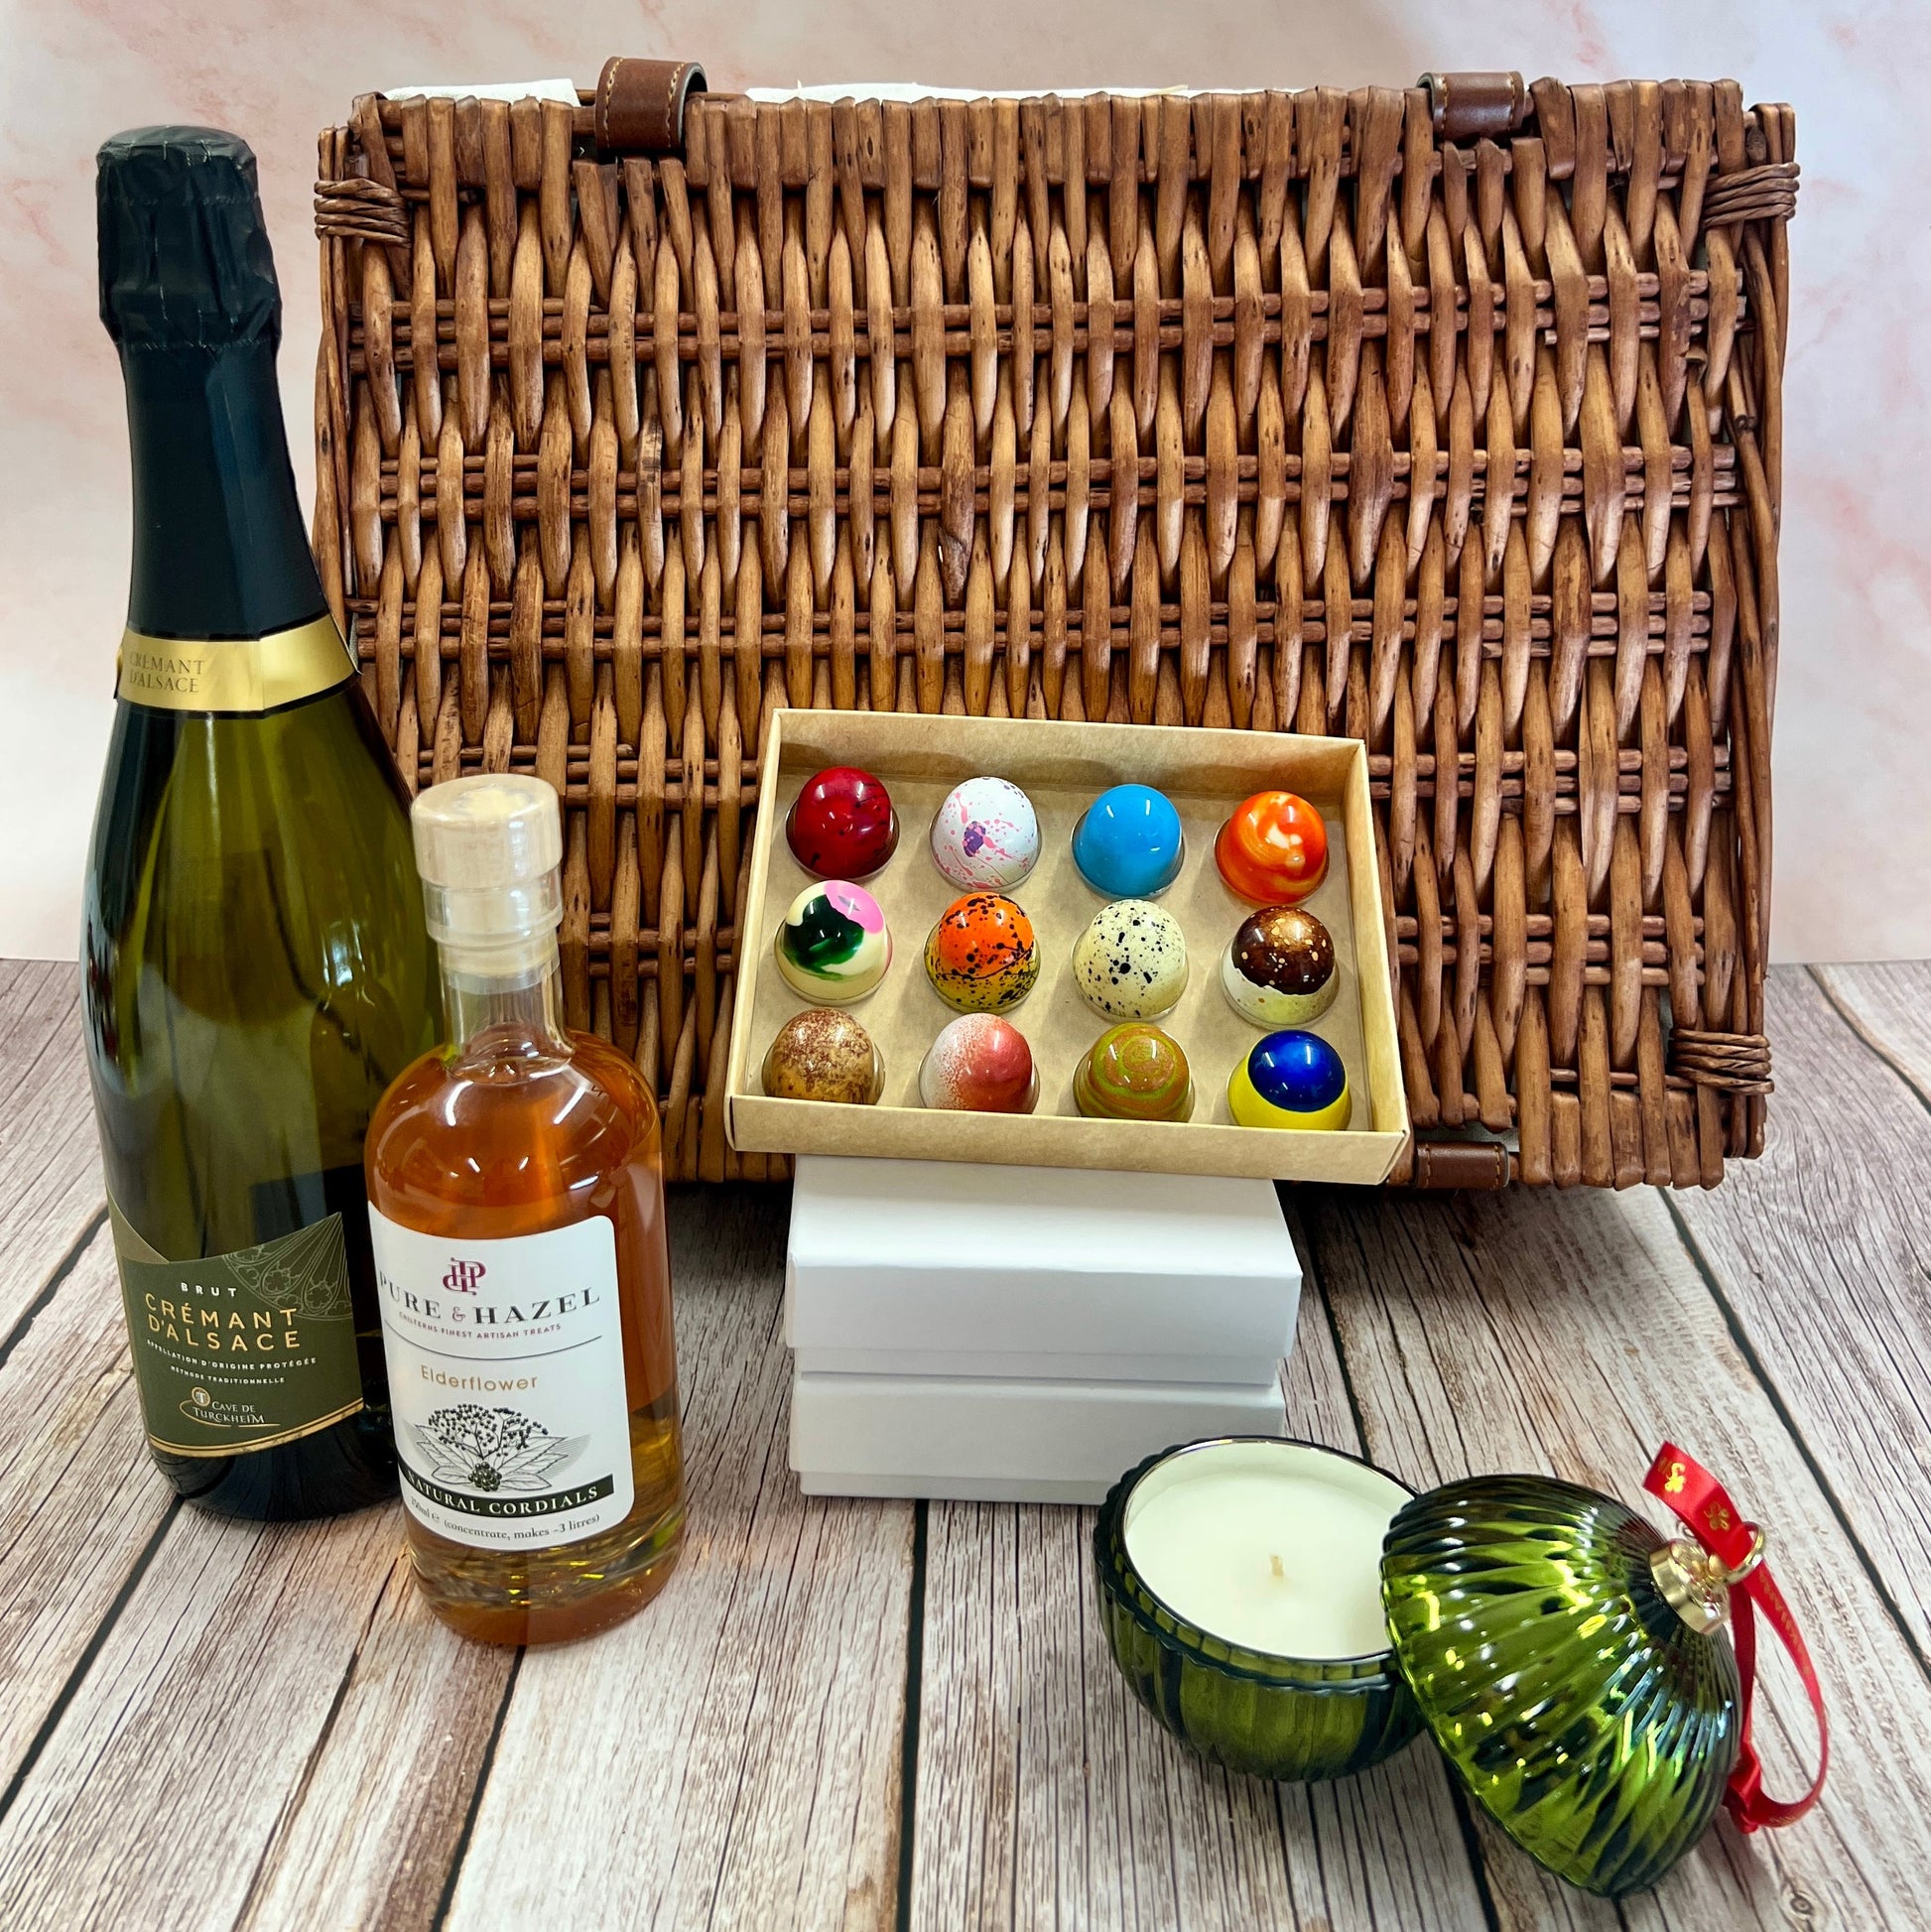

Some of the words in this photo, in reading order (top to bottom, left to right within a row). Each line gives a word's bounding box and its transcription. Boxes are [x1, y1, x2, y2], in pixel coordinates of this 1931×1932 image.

[181, 1282, 236, 1297] BRUT
[379, 1270, 442, 1320] PURE
[451, 1306, 466, 1323] &
[472, 1286, 600, 1325] HAZEL
[145, 1293, 297, 1330] CRÉMANT
[148, 1314, 301, 1352] D'ALSACE
[476, 1330, 519, 1340] ARTISAN
[523, 1323, 562, 1337] TREATS
[421, 1364, 538, 1391] Elderflower
[408, 1470, 480, 1513] NATURAL
[489, 1485, 597, 1515] CORDIALS
[444, 1519, 511, 1541] (concentrate,
[514, 1527, 550, 1539] makes
[569, 1513, 600, 1531] litres)
